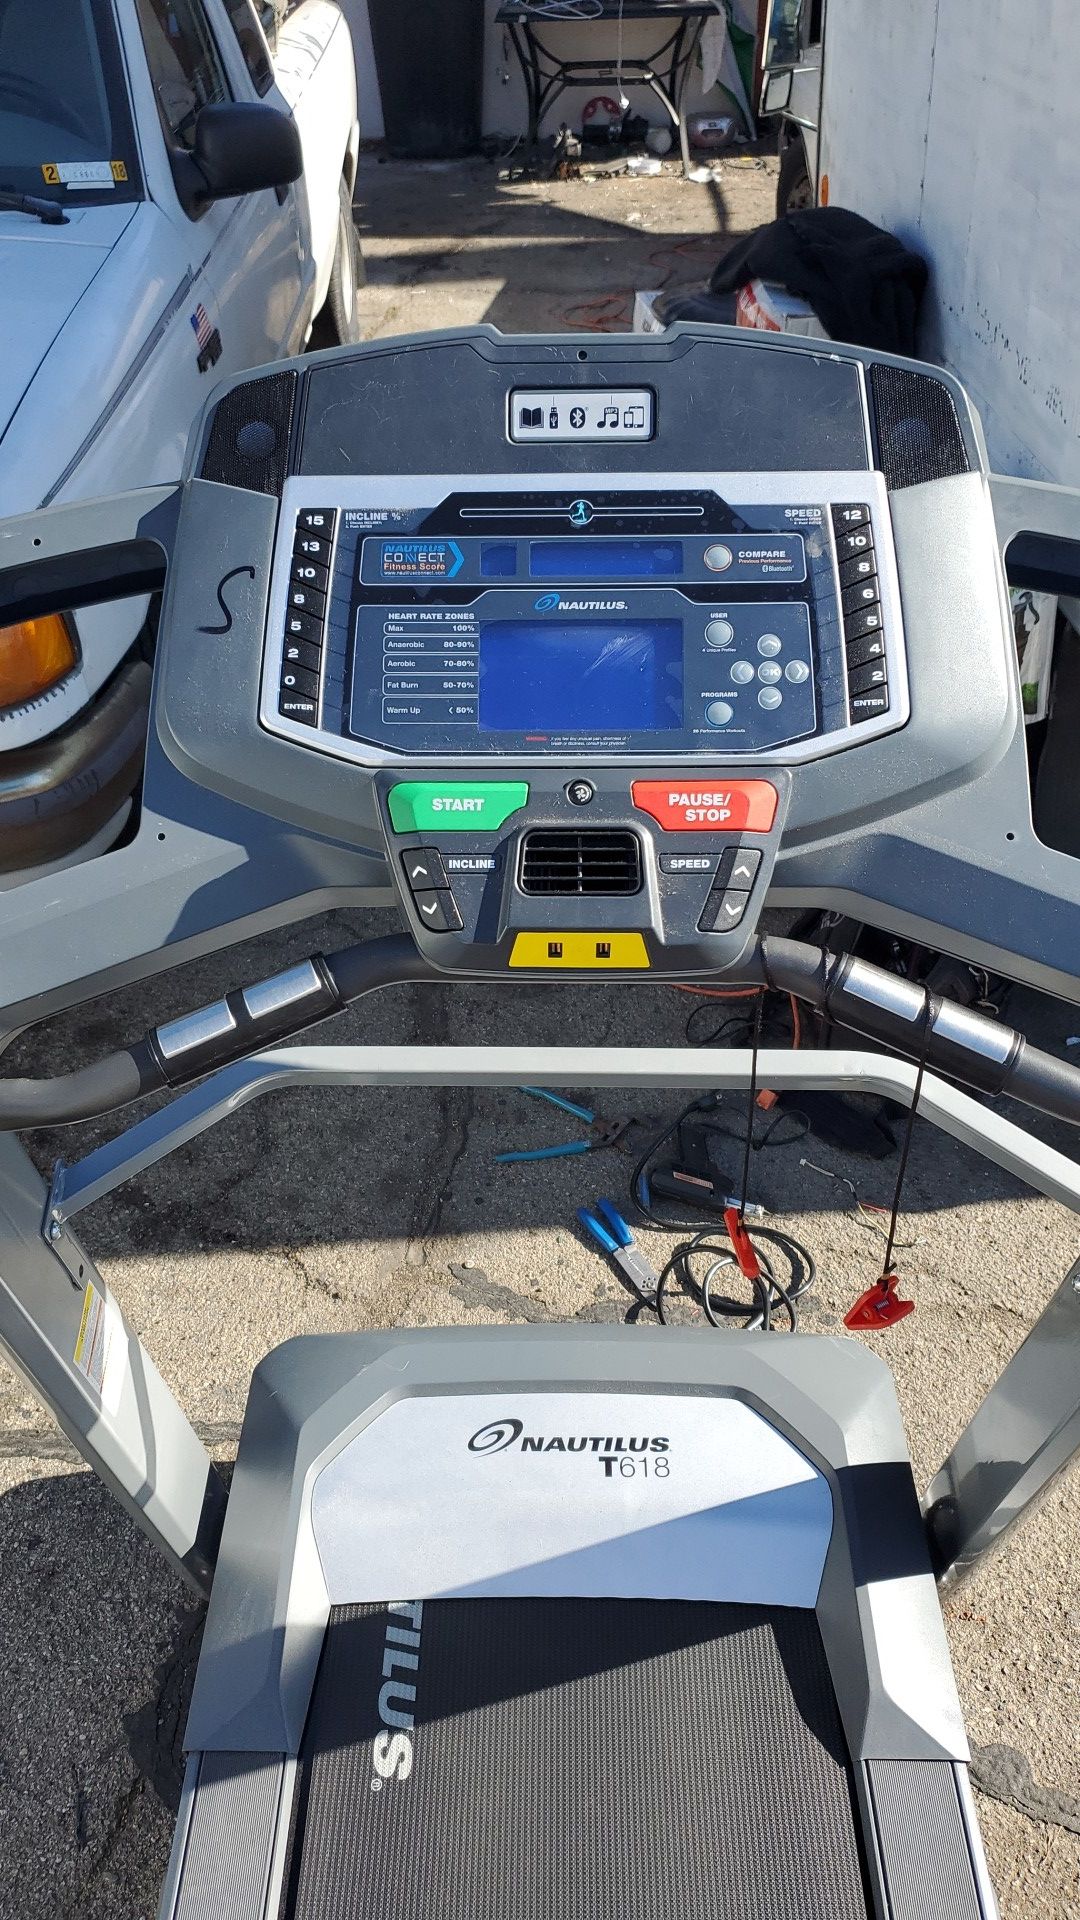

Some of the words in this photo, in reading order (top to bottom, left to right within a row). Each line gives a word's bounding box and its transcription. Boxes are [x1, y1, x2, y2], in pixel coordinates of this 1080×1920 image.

[45, 166, 57, 180] 2
[345, 512, 388, 521] INCLINE
[391, 512, 401, 521] %
[784, 509, 821, 517] SPEED
[842, 510, 862, 520] 12
[305, 515, 325, 526] 15
[847, 536, 867, 546] 10
[302, 542, 320, 551] 13
[738, 550, 786, 558] COMPARE
[858, 562, 871, 572] 8
[297, 568, 316, 578] 10
[293, 594, 305, 604] 8
[862, 589, 875, 599] 6
[290, 621, 301, 631] 5
[866, 616, 878, 626] 5
[869, 643, 881, 653] 4
[287, 649, 299, 658] 2
[761, 668, 782, 676] OK
[871, 671, 884, 681] 2
[284, 676, 295, 685] 0
[387, 681, 399, 689] Fat
[443, 681, 474, 689] 50-70%
[283, 703, 314, 711] ENTER
[854, 699, 884, 707] ENTER
[409, 707, 421, 715] Up
[432, 798, 485, 811] START
[668, 793, 731, 807] PAUSE/
[685, 809, 731, 822] STOP
[448, 859, 496, 869] INCLINE
[669, 859, 711, 869] SPEED
[520, 1436, 671, 1452] NAUTILUS
[598, 1455, 671, 1478] T618
